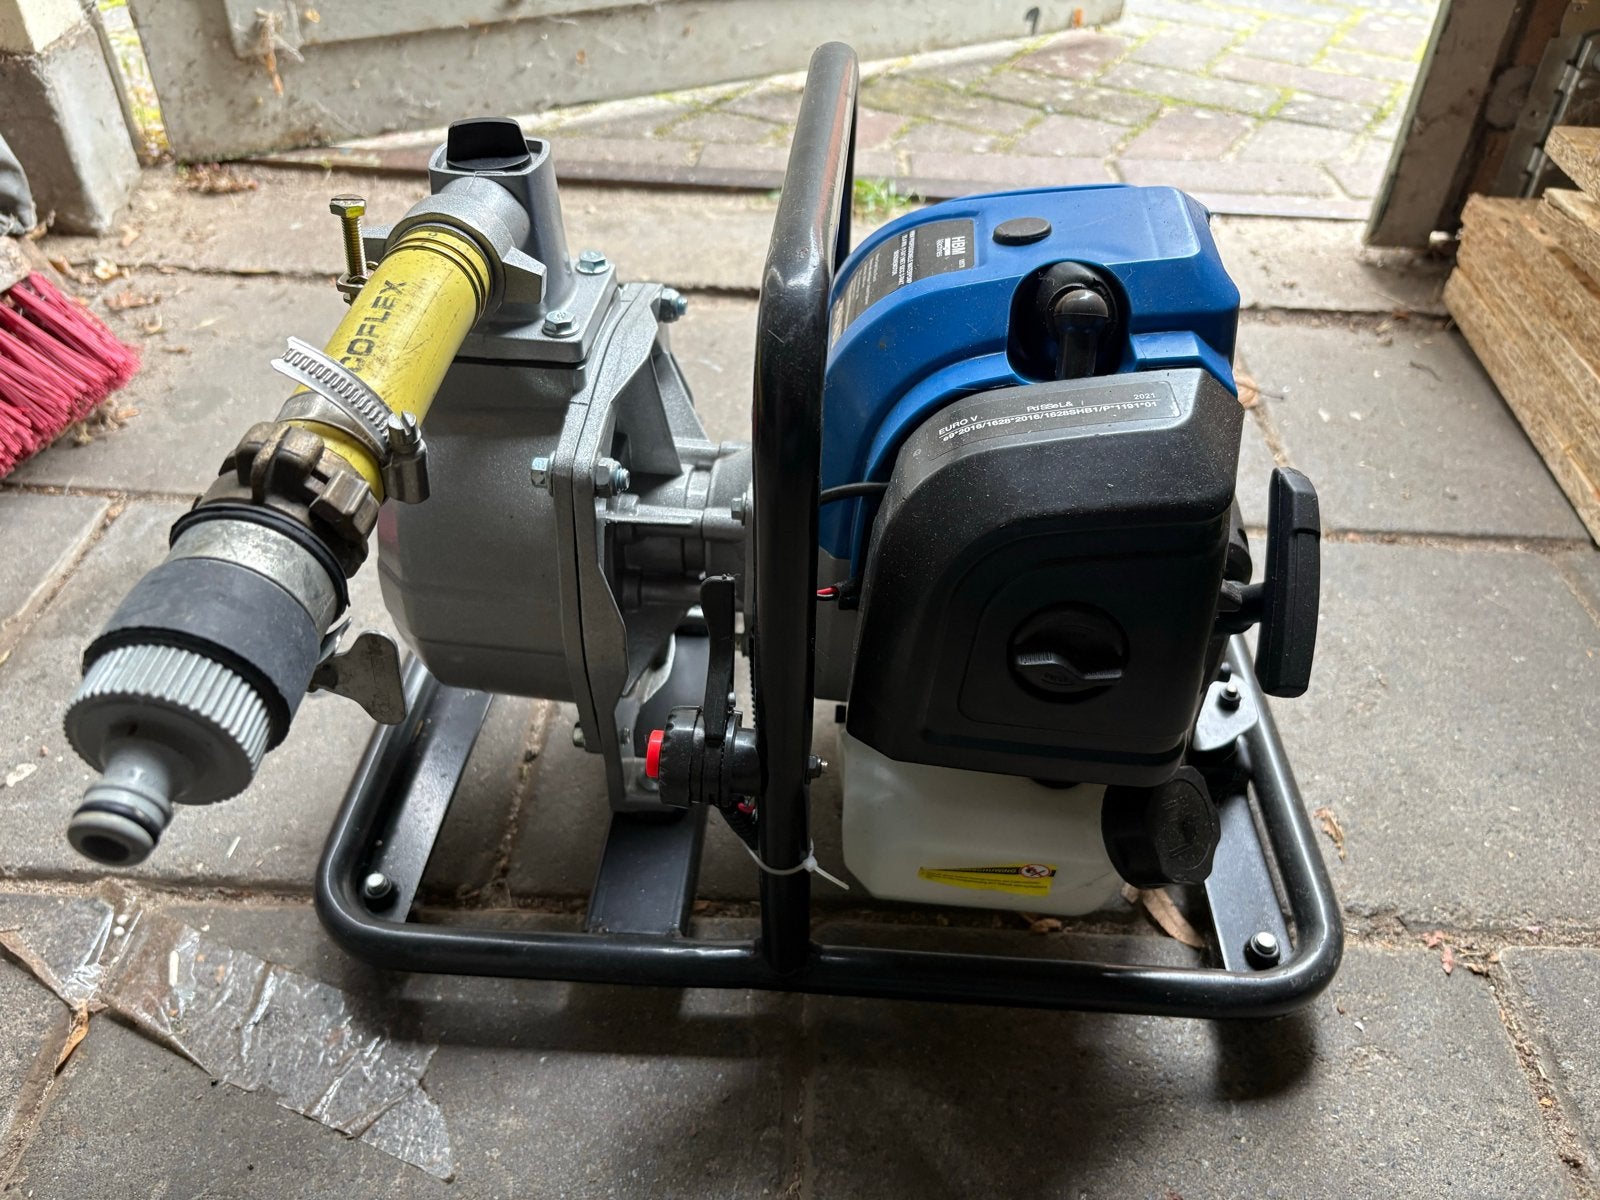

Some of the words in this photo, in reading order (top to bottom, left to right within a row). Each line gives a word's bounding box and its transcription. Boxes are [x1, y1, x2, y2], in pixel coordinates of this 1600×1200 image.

[951, 235, 966, 256] HBM
[1133, 392, 1156, 400] 2021
[938, 418, 968, 436] EURO
[970, 414, 978, 422] V
